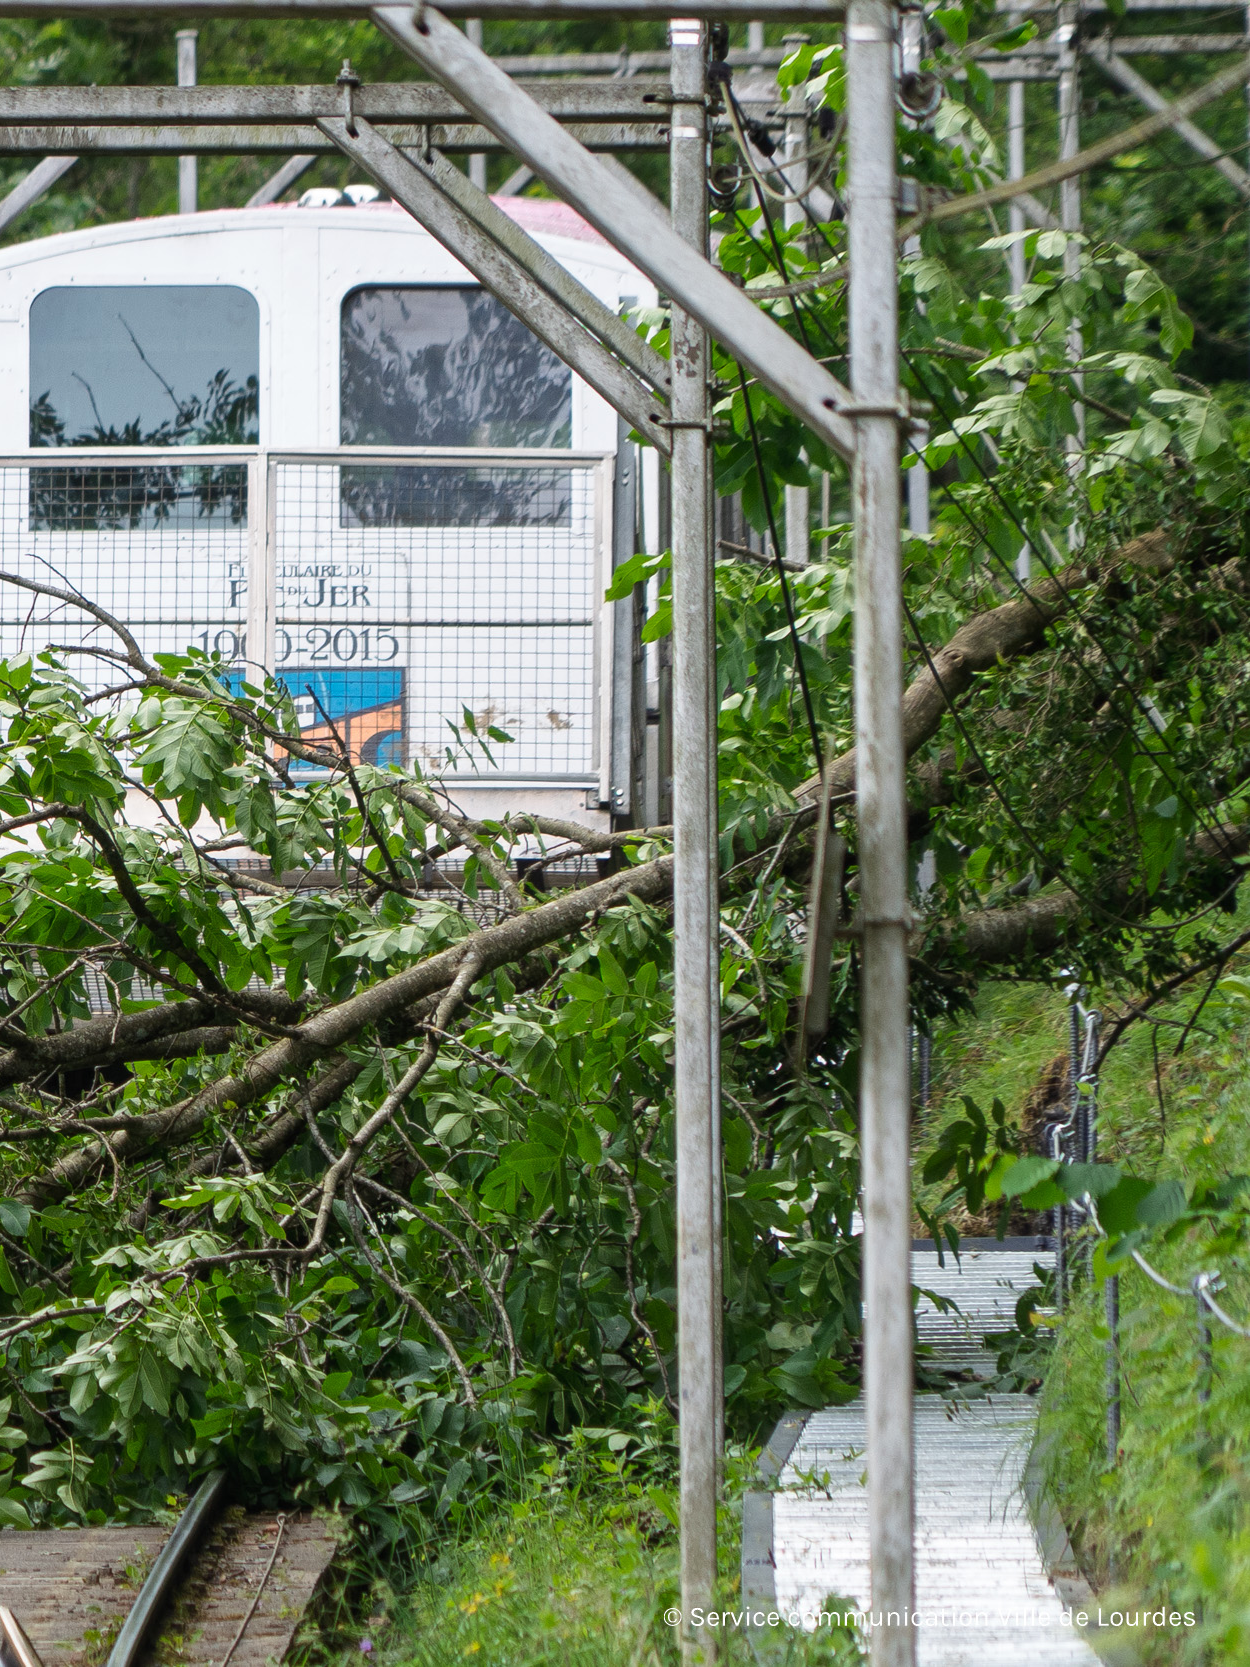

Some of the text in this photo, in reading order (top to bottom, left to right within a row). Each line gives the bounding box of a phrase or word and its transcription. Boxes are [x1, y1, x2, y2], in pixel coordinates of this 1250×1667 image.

[349, 564, 372, 577] DU
[288, 586, 307, 595] DU
[304, 579, 371, 607] JER
